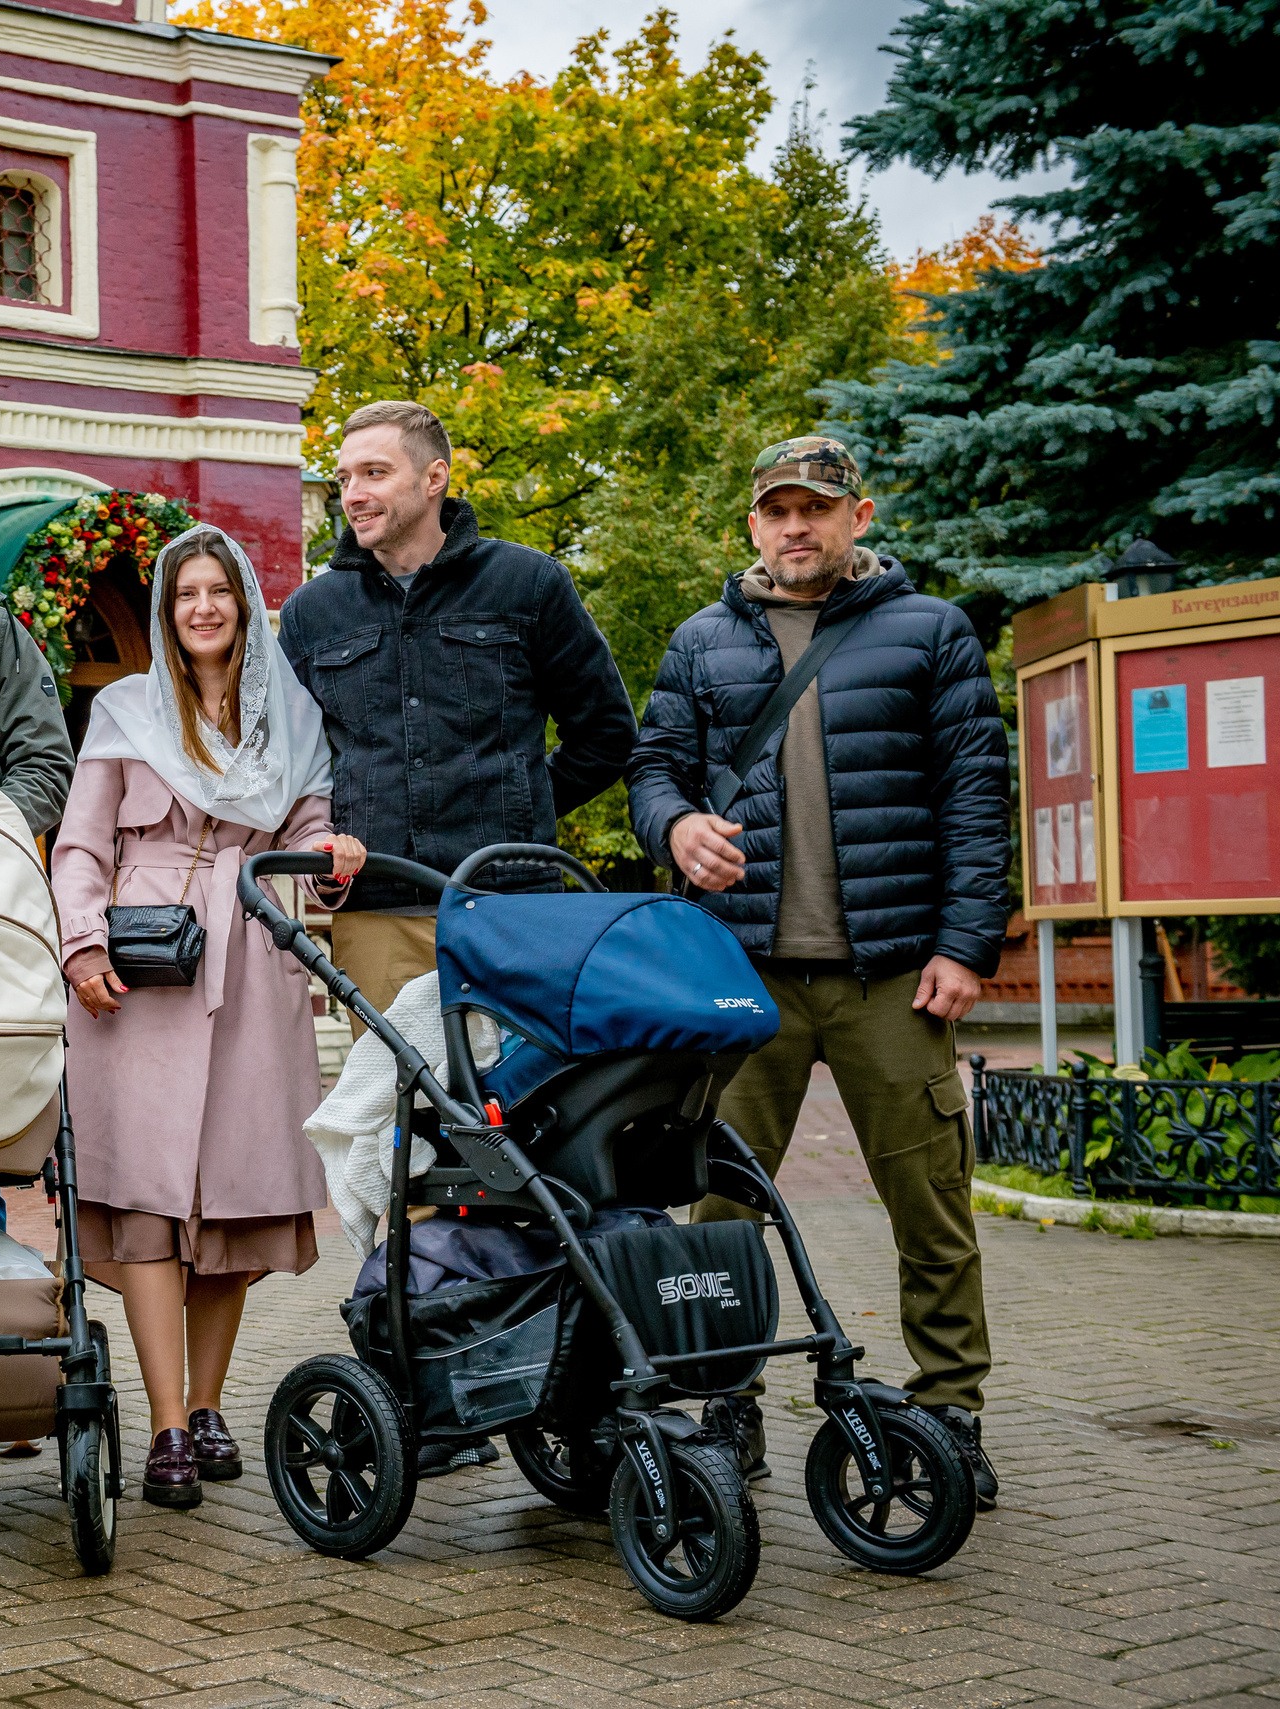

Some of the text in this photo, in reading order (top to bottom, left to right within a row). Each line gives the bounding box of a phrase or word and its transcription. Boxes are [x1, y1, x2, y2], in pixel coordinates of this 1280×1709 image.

[1172, 591, 1279, 615] Катехизация
[714, 998, 759, 1008] SONIC
[353, 1004, 377, 1030] SONIC
[657, 1272, 734, 1305] SONIC
[720, 1298, 741, 1309] plus
[842, 1408, 882, 1470] VERDI SONIC
[635, 1441, 663, 1487] VERDI
